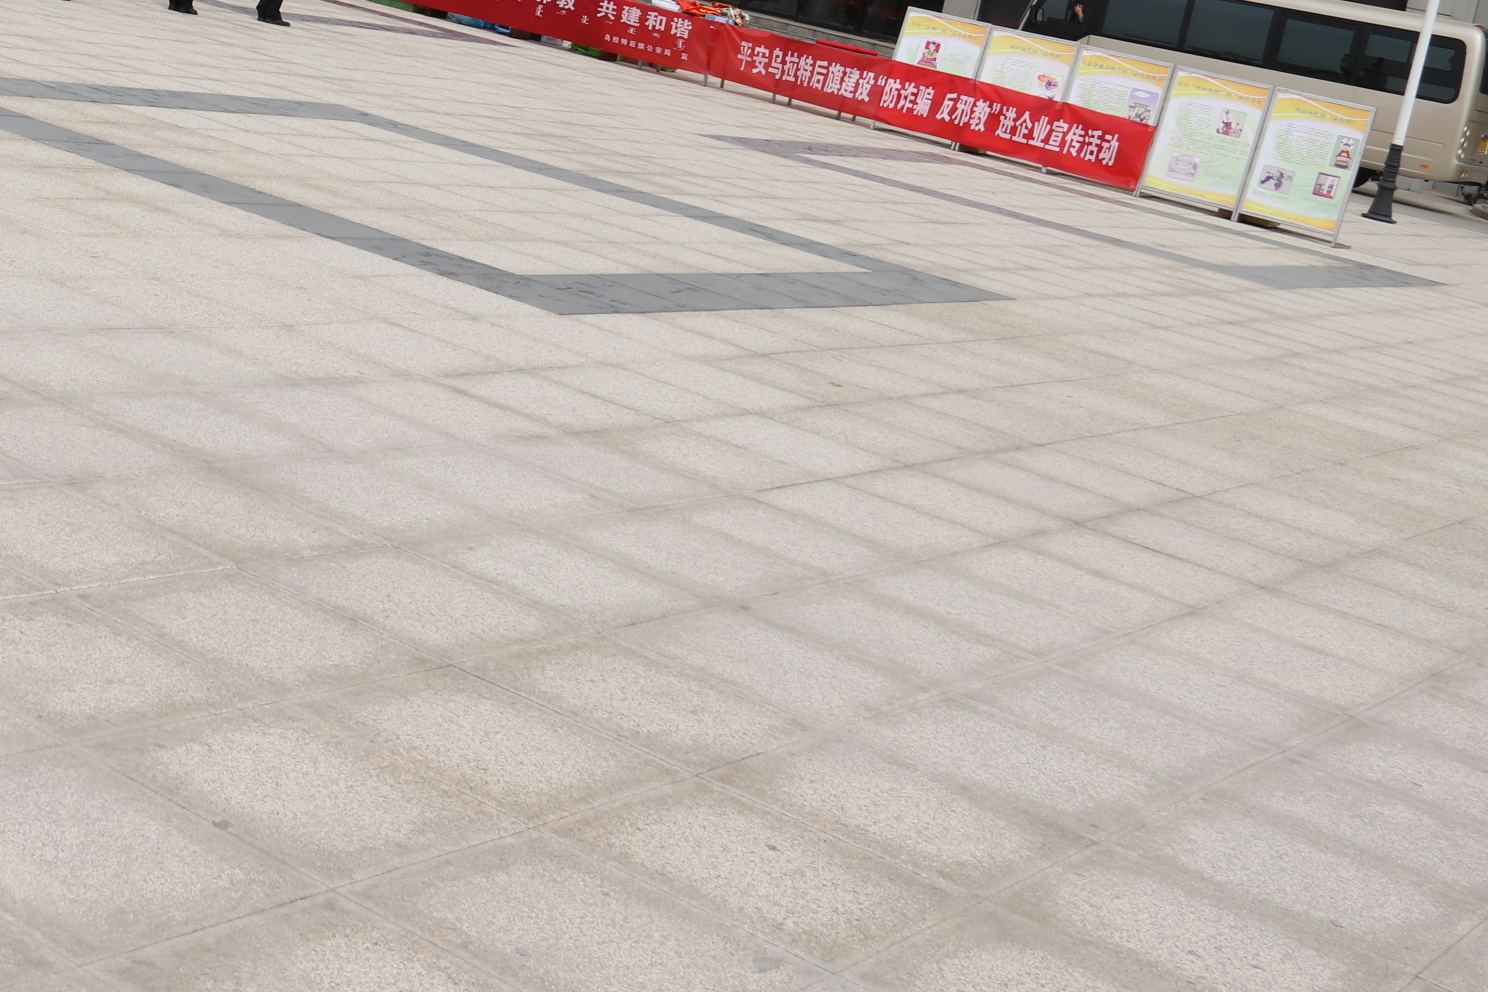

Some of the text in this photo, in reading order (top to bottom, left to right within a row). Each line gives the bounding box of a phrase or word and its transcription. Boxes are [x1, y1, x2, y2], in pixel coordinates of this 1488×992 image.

[597, 0, 692, 40] 共建和谐
[604, 34, 671, 57] 乌拉特后旗公安局
[736, 40, 932, 119] 平安乌拉特后旗建设“防诈骗
[935, 89, 1120, 167] 反邪教”进企业宣传活动
